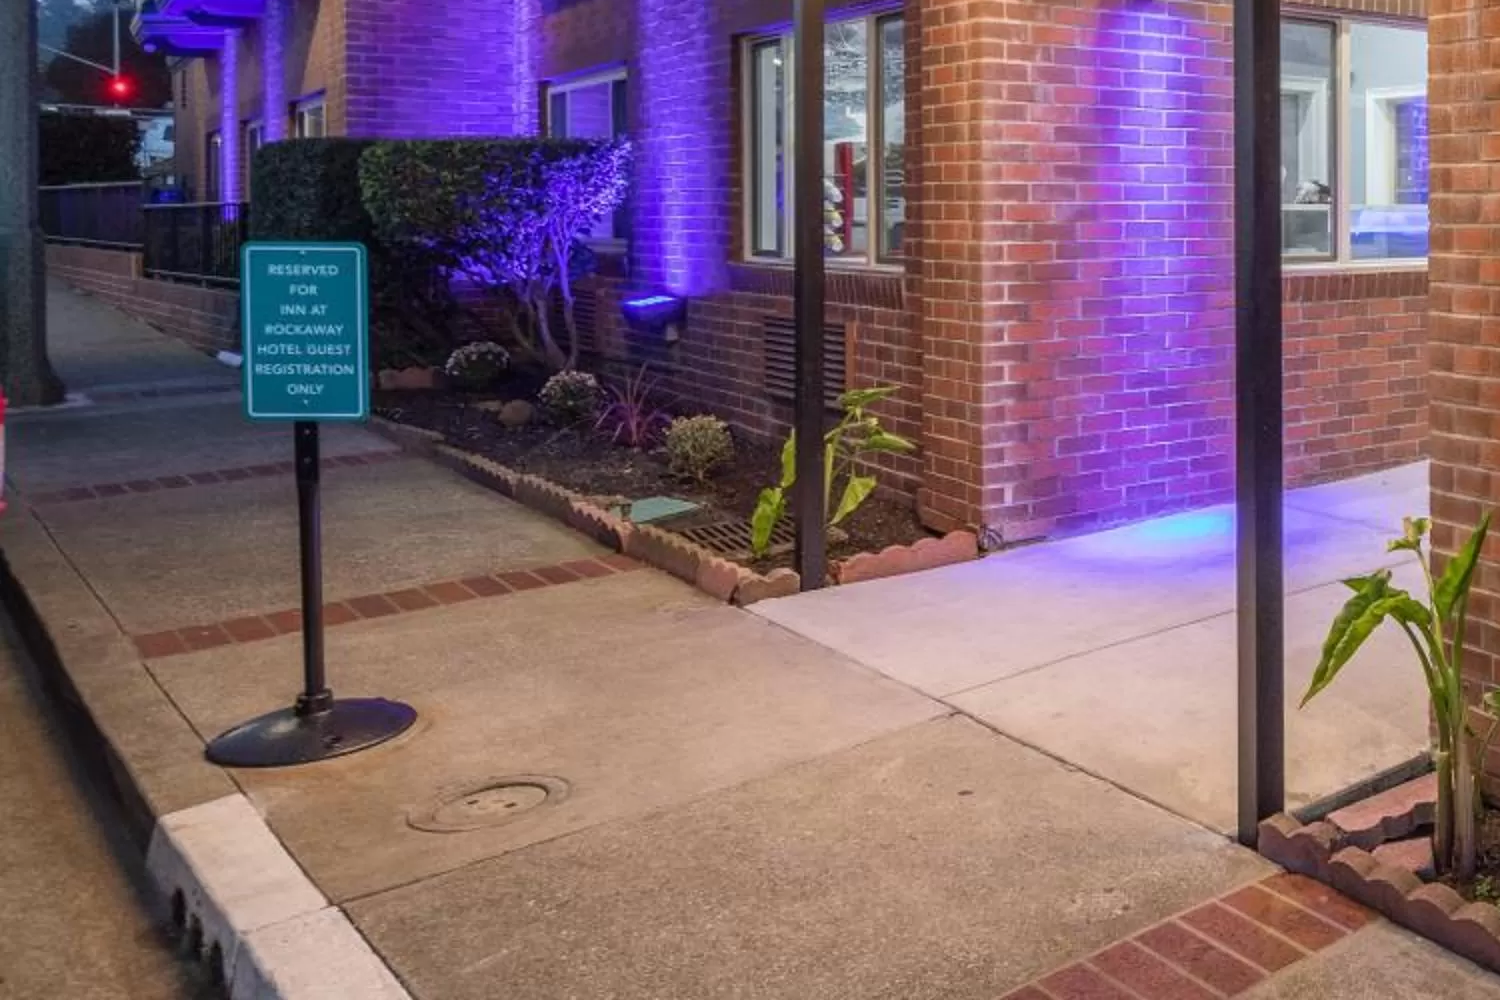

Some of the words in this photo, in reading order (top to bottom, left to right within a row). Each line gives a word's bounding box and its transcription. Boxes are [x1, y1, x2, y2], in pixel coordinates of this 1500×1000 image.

[267, 263, 339, 277] RESERVED
[289, 283, 319, 296] FOR
[280, 303, 307, 316] INN
[310, 303, 328, 316] AT
[265, 323, 345, 336] ROCKAWAY
[257, 343, 301, 356] HOTEL
[307, 343, 352, 356] GUEST
[255, 363, 355, 376] REGISTRATION
[287, 383, 325, 396] ONLY
